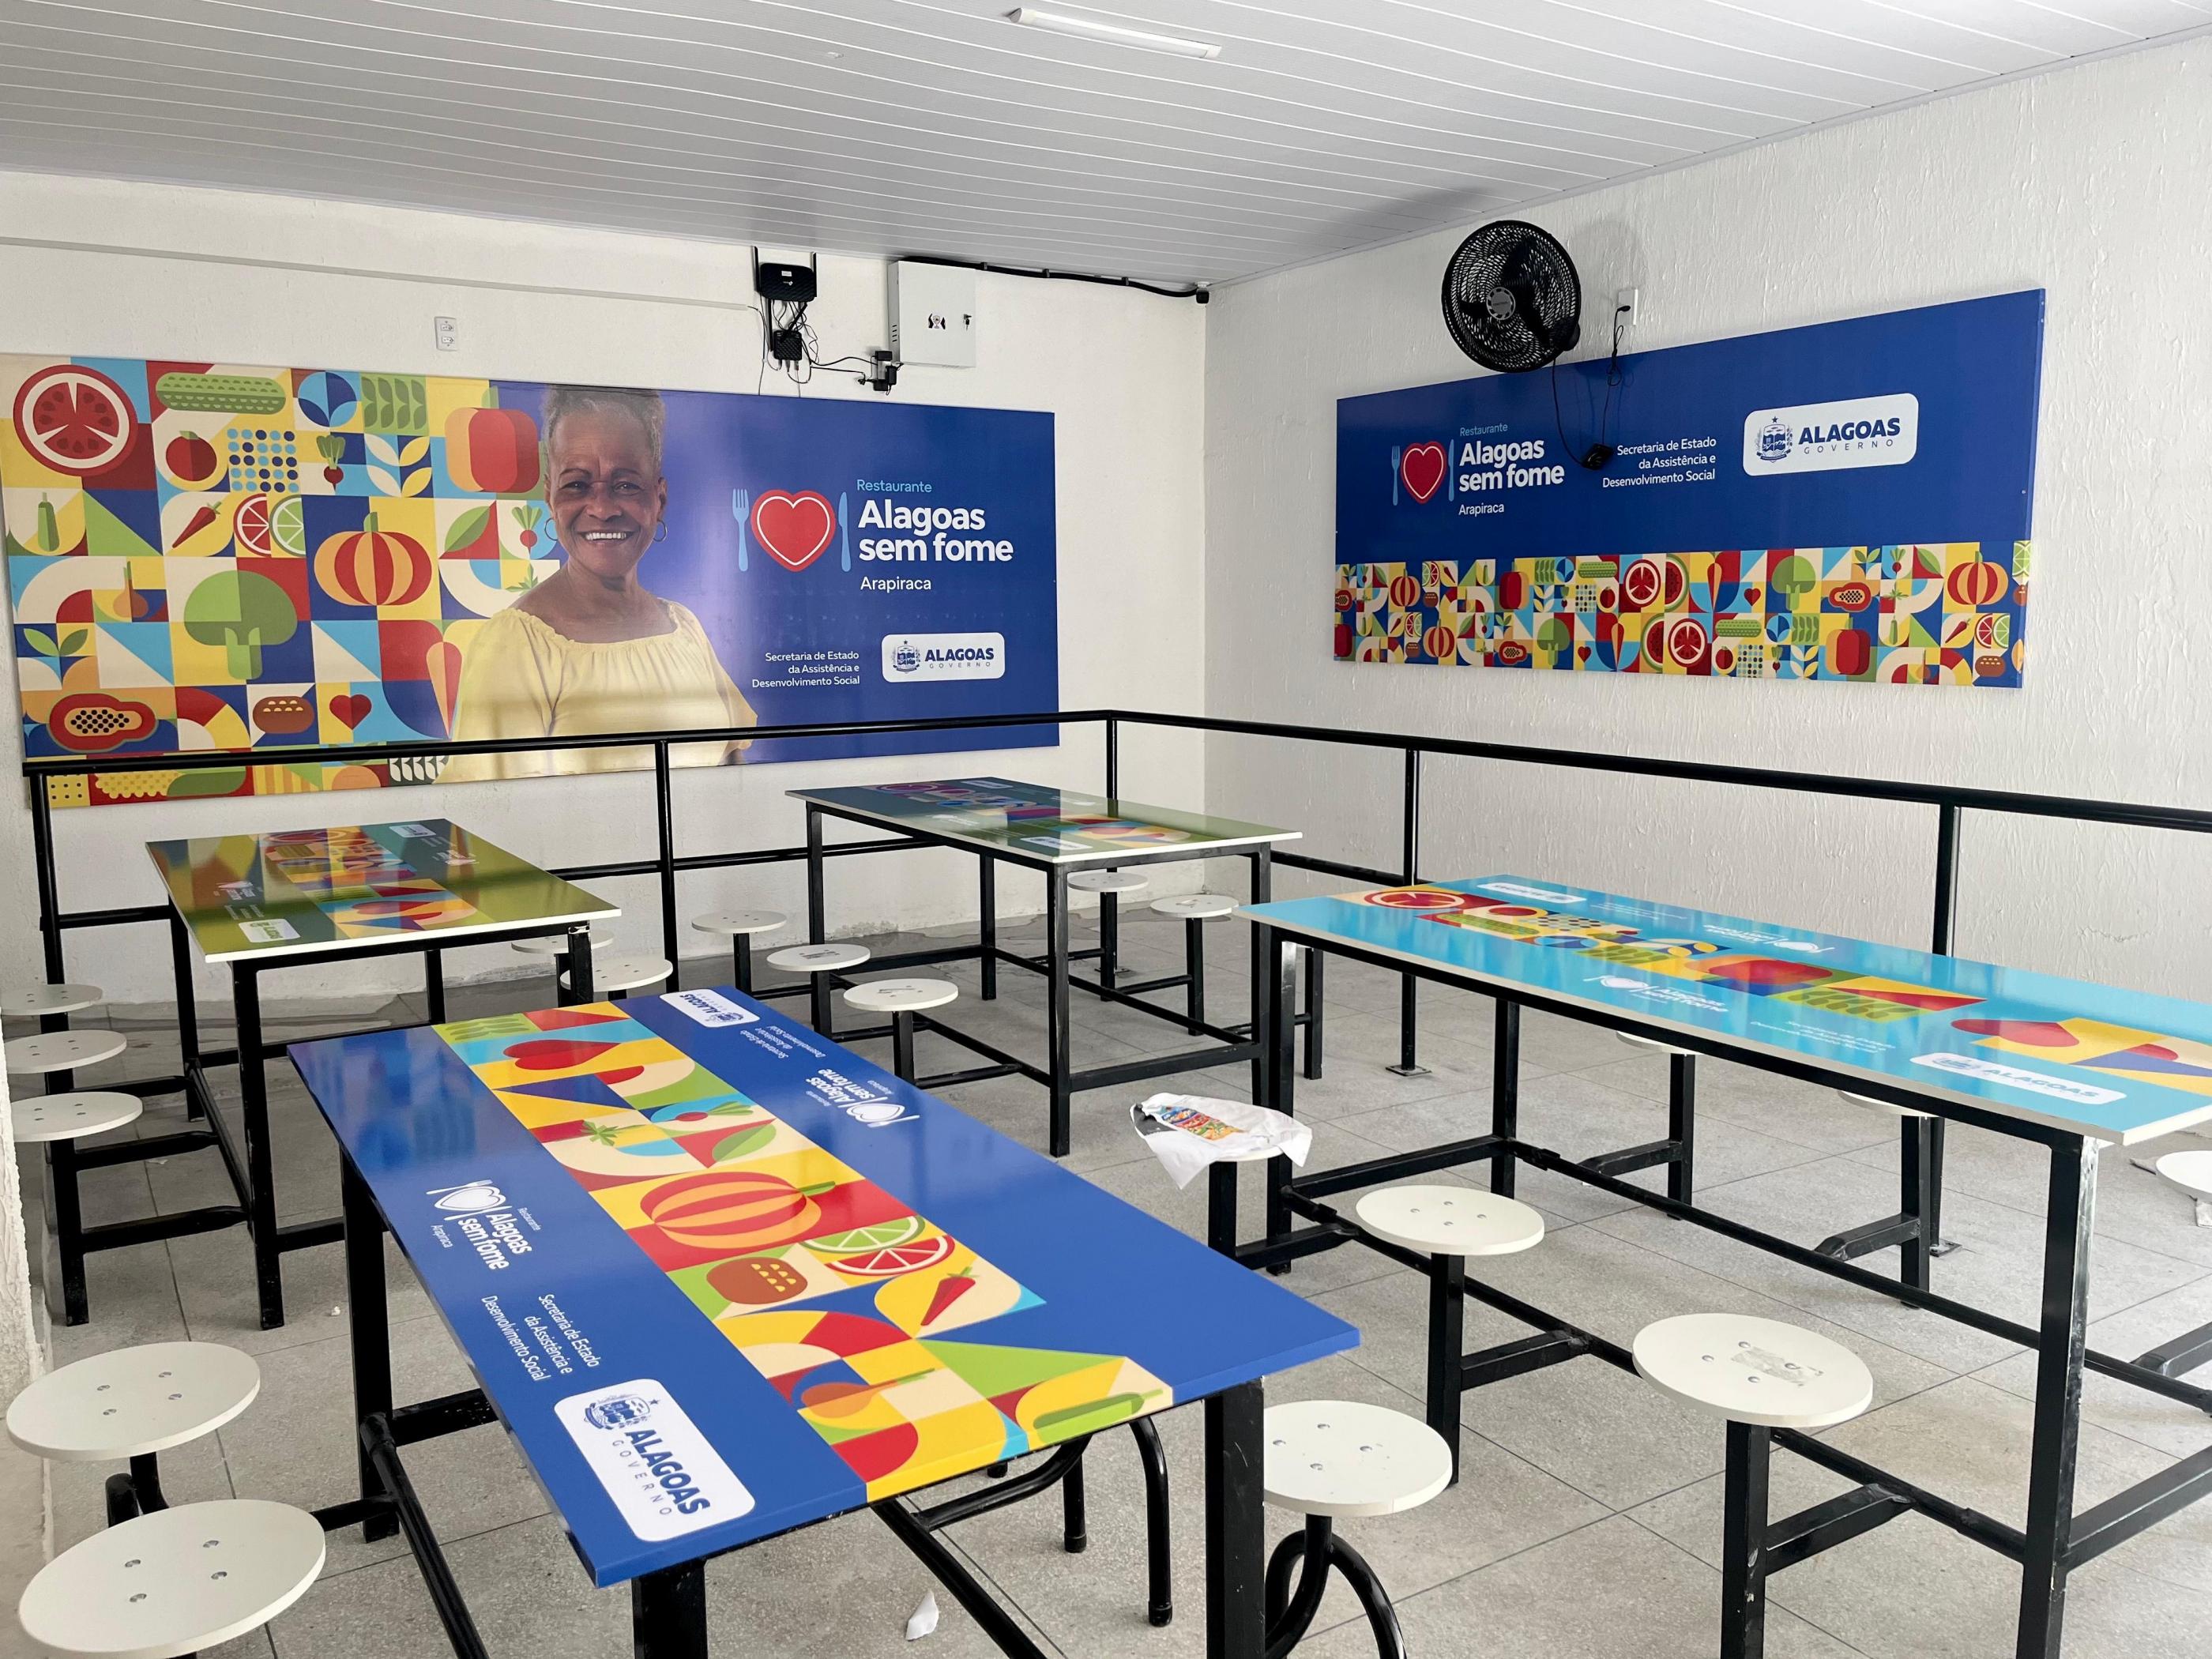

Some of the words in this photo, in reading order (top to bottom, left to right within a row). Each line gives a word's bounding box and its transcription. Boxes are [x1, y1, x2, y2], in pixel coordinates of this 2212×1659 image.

[1460, 423, 1508, 436] Restaurante
[1798, 417, 1901, 446] ALAGOAS
[1459, 440, 1545, 468] Alagoas
[1617, 442, 1665, 456] Secretaria
[1666, 440, 1679, 451] de
[1681, 436, 1717, 450] Estado
[1804, 438, 1894, 454] GOVERNO
[1638, 458, 1651, 469] da
[1652, 453, 1708, 468] Assistência
[857, 480, 932, 493] Restaurante
[1459, 471, 1503, 491] sem
[1507, 463, 1565, 487] fome
[1602, 472, 1684, 488] Desenvolvimento
[1686, 468, 1715, 482] Social
[858, 498, 986, 536] Alagoas
[1458, 502, 1505, 517] Arapiraca
[859, 538, 927, 562] sem
[933, 532, 1014, 562] fome
[860, 576, 931, 593] Arapiraca
[765, 652, 813, 662] Secretaria
[814, 652, 826, 660] de
[828, 650, 860, 660] Estado
[924, 648, 995, 662] ALAGOAS
[788, 664, 800, 674] da
[801, 663, 854, 674] Assistência
[751, 676, 832, 688] Desenvolvimento
[833, 675, 860, 686] Social
[818, 1068, 853, 1086] fome
[1983, 1069, 2100, 1097] ALAGOAS
[806, 1077, 856, 1103] Alagoas
[844, 1084, 875, 1100] sem
[458, 1217, 489, 1242] sem
[485, 1213, 532, 1255] Alagoas
[472, 1239, 510, 1270] fome
[524, 1315, 542, 1327] da
[539, 1294, 574, 1330] Secretaria
[481, 1296, 530, 1357] Desenvolvimento
[521, 1355, 551, 1381] Social
[563, 1330, 581, 1340] de
[530, 1326, 571, 1368] Assistência
[571, 1338, 601, 1367] Estado
[611, 1439, 672, 1515] GOVERNO
[624, 1429, 711, 1514] ALAGOAS
